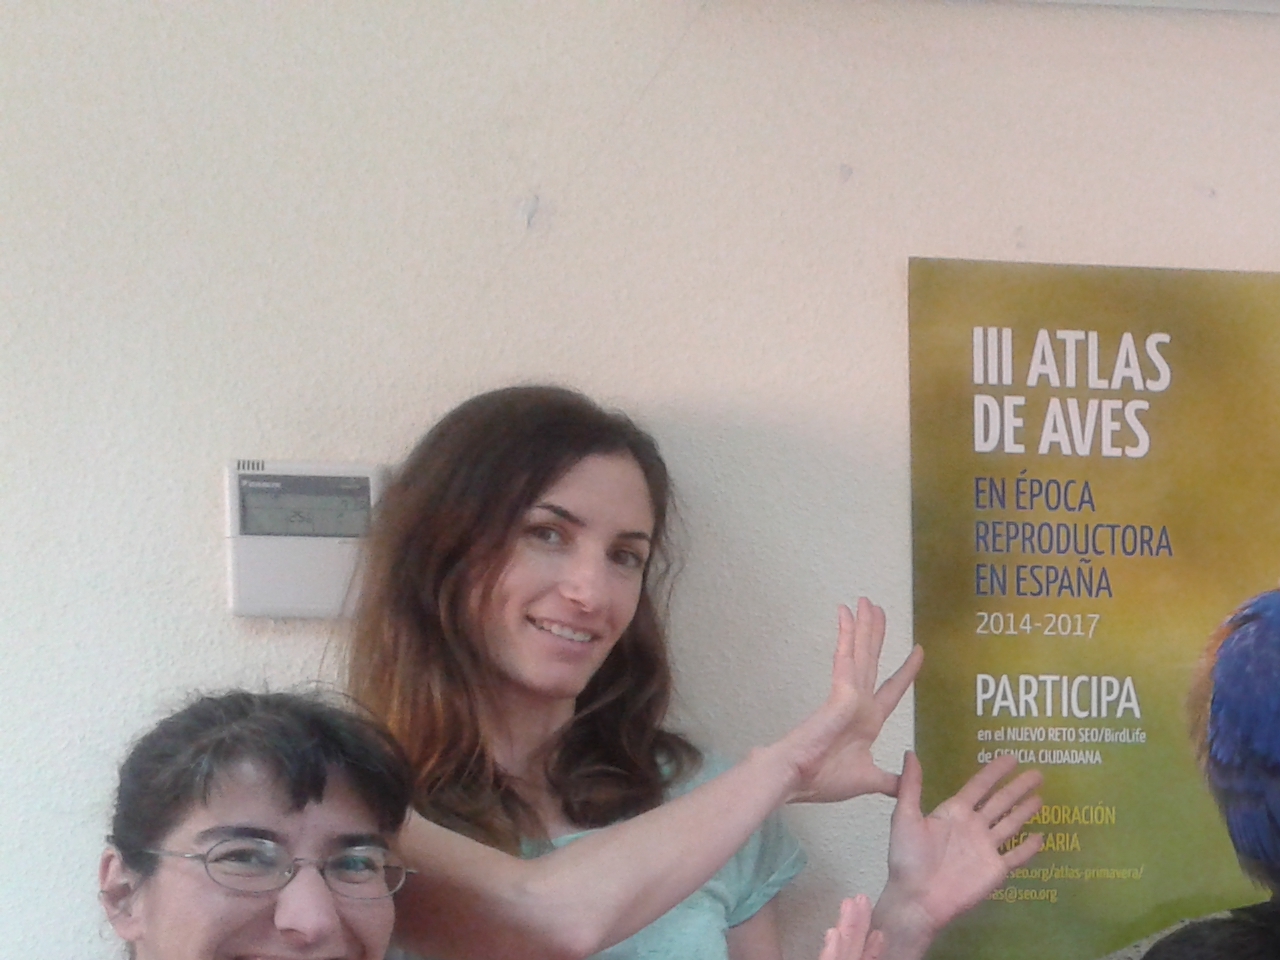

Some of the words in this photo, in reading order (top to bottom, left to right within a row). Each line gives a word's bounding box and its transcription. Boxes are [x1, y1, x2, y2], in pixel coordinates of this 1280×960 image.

[972, 326, 1013, 386] III
[1026, 328, 1172, 392] ATLAS
[973, 394, 1026, 453] DE
[1037, 396, 1151, 458] AVES
[974, 476, 1006, 511] EN
[1014, 468, 1096, 513] ÉPOCA
[975, 520, 1173, 557] REPRODUCTORA
[975, 563, 1007, 597] EN
[1015, 557, 1113, 599] ESPAÑA
[975, 612, 1100, 638] 2014-2017
[975, 673, 1142, 719] PARTICIPA
[977, 729, 992, 741] en
[994, 727, 1005, 741] el
[1006, 727, 1046, 742] NUEVO
[1048, 727, 1076, 742] RETO
[977, 748, 992, 764] de
[1038, 749, 1102, 764] CIUDADANA
[1012, 801, 1116, 825] ABORACIÓN
[1005, 863, 1144, 882] .seo.org/atlas-primavera/
